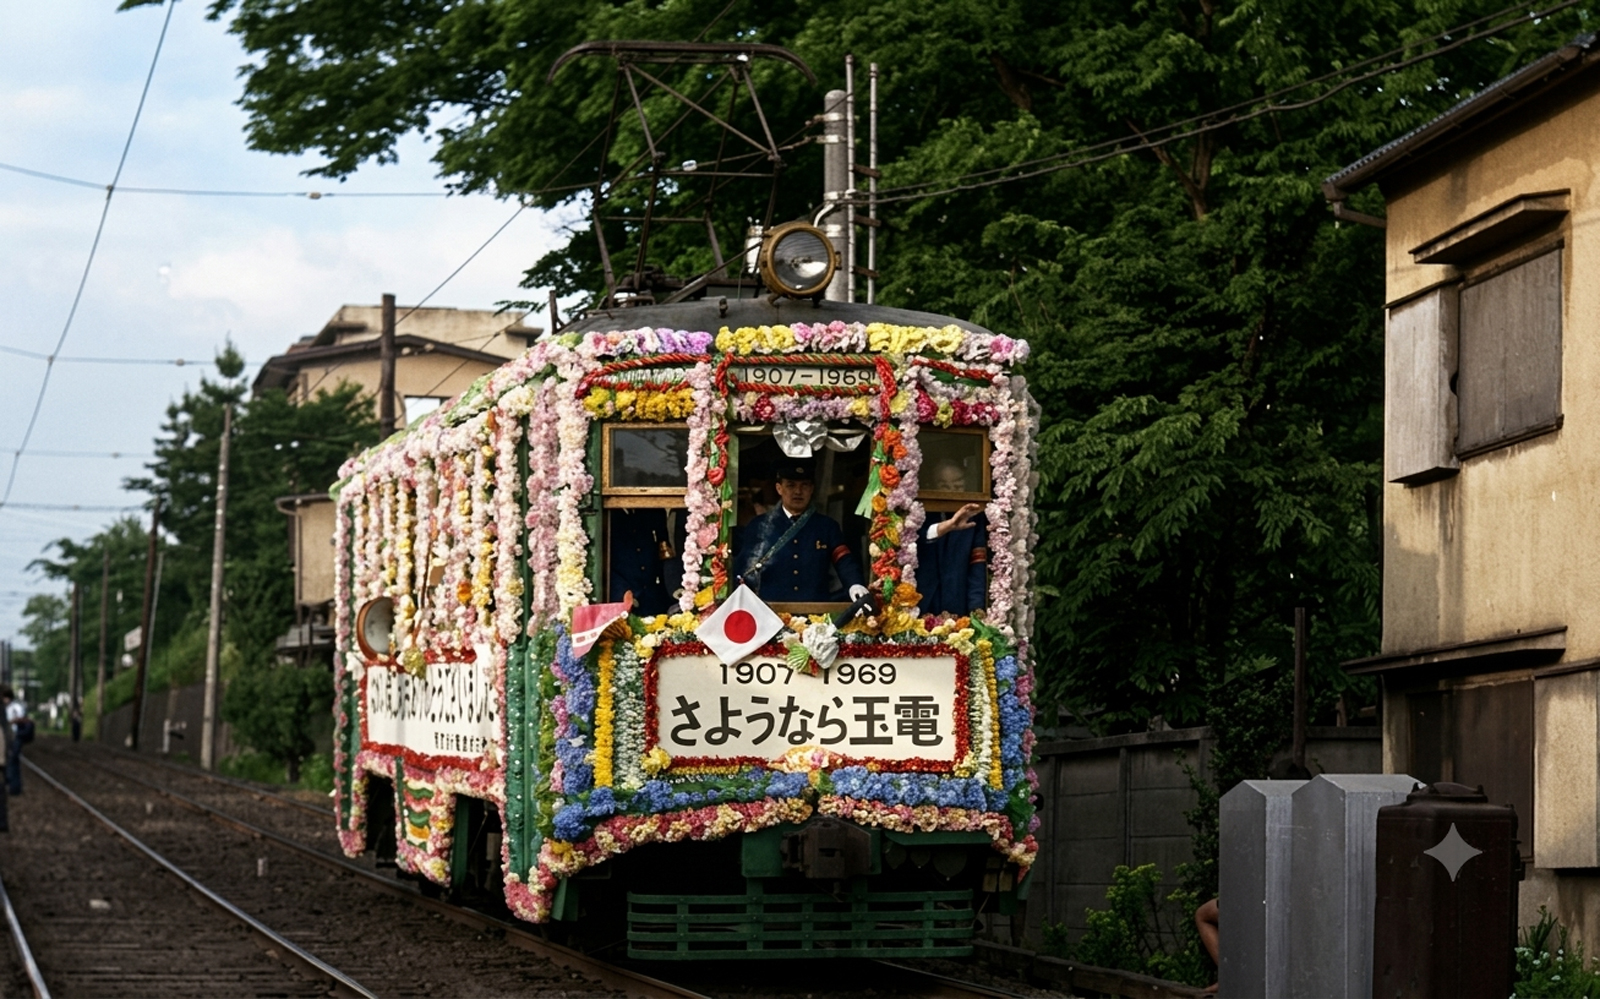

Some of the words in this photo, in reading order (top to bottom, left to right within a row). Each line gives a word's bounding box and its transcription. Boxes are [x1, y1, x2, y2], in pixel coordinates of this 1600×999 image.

[670, 695, 944, 746] さようなら玉電
